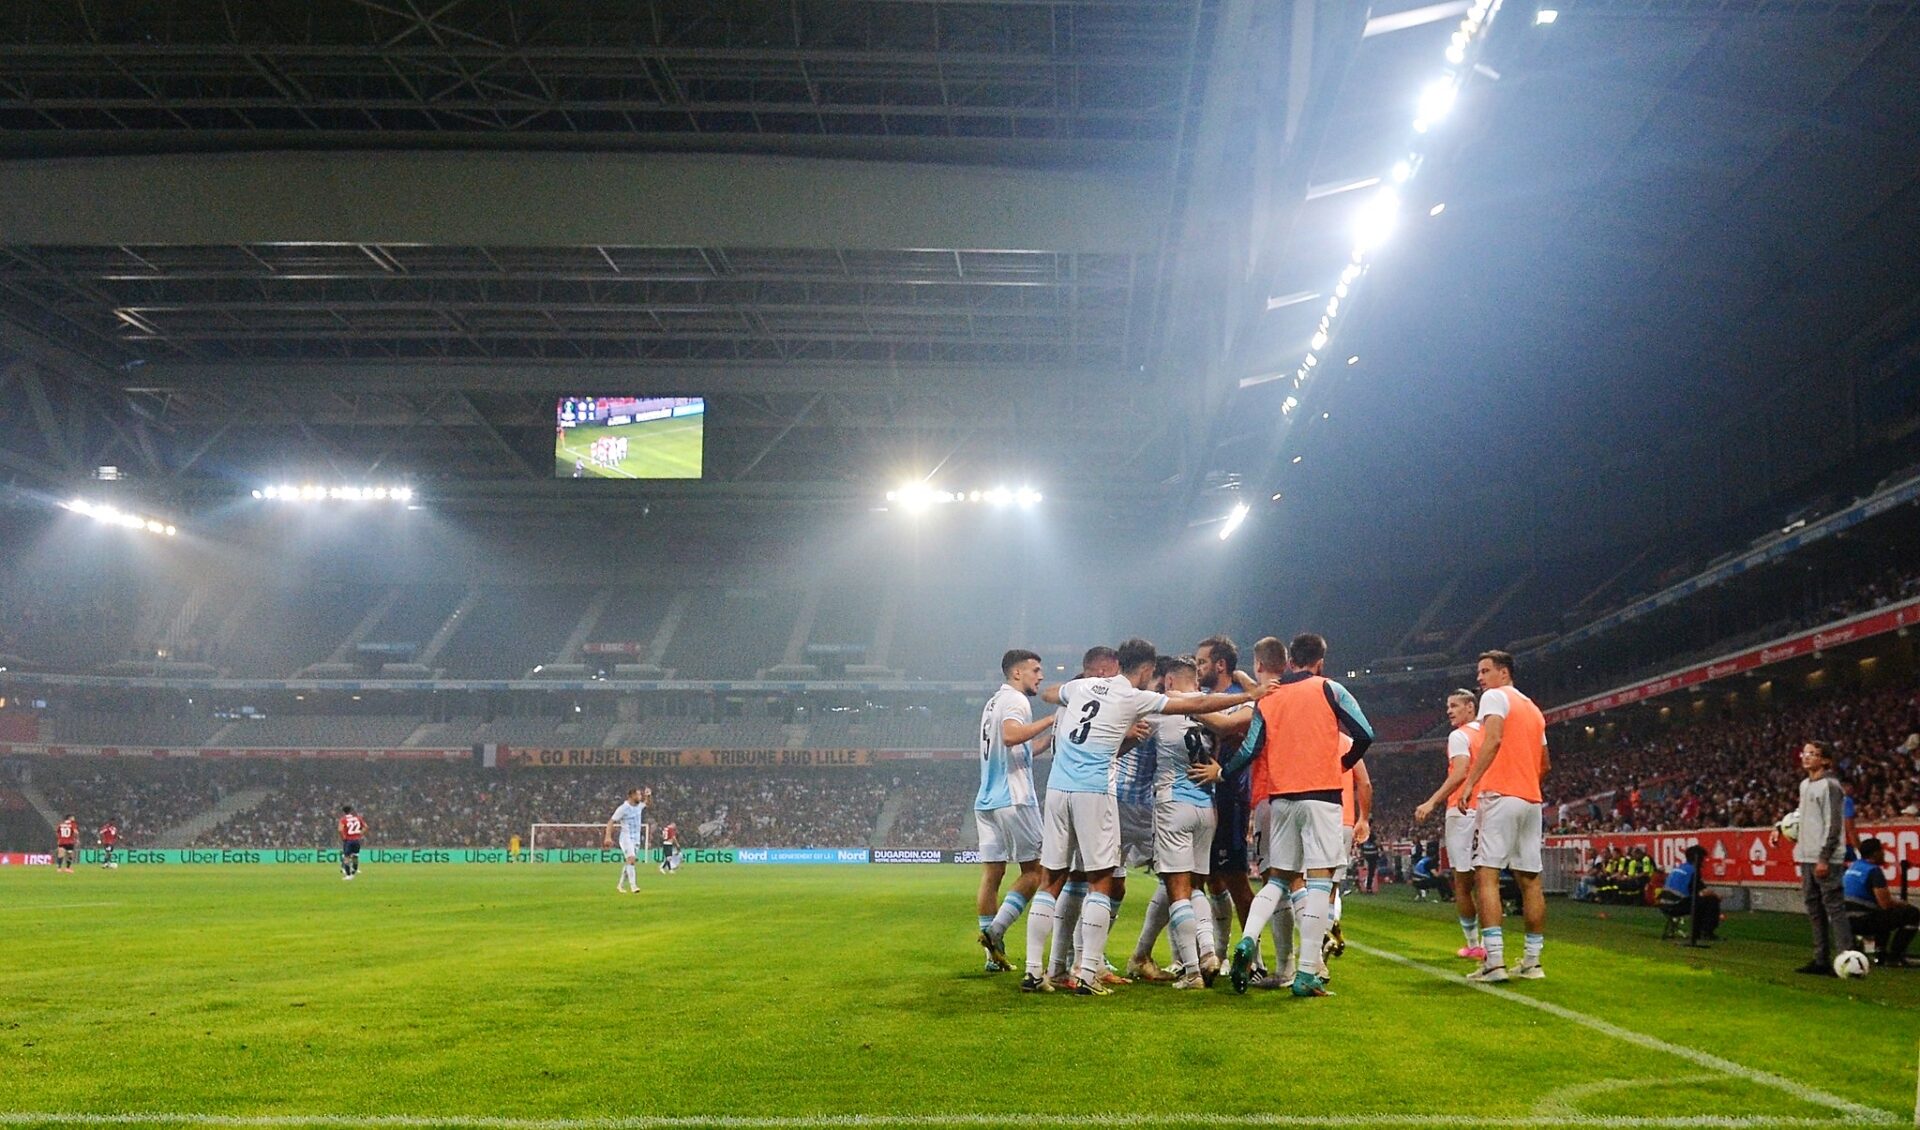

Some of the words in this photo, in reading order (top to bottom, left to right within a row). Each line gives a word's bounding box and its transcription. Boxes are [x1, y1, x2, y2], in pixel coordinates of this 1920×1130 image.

[1069, 700, 1101, 745] 3
[982, 720, 991, 761] 5
[540, 751, 563, 764] GO
[569, 750, 624, 764] RIJSEL
[630, 750, 682, 765] SPIRIT
[711, 751, 775, 765] TRIBUNE
[781, 751, 811, 765] SUD
[816, 750, 856, 765] LILLE
[60, 827, 71, 838] 10
[347, 821, 361, 834] 22
[128, 850, 166, 863] Eats
[181, 850, 218, 863] Uber
[222, 850, 260, 863] Eats
[276, 850, 313, 863] Uber
[370, 850, 407, 863] Uber
[412, 850, 450, 863] Eats
[465, 850, 502, 863] Uber
[560, 850, 597, 863] Uber
[696, 850, 733, 863] Eats
[739, 850, 768, 861] Nord
[838, 850, 867, 861] Nord
[874, 850, 941, 859] DUGARDIN.COM
